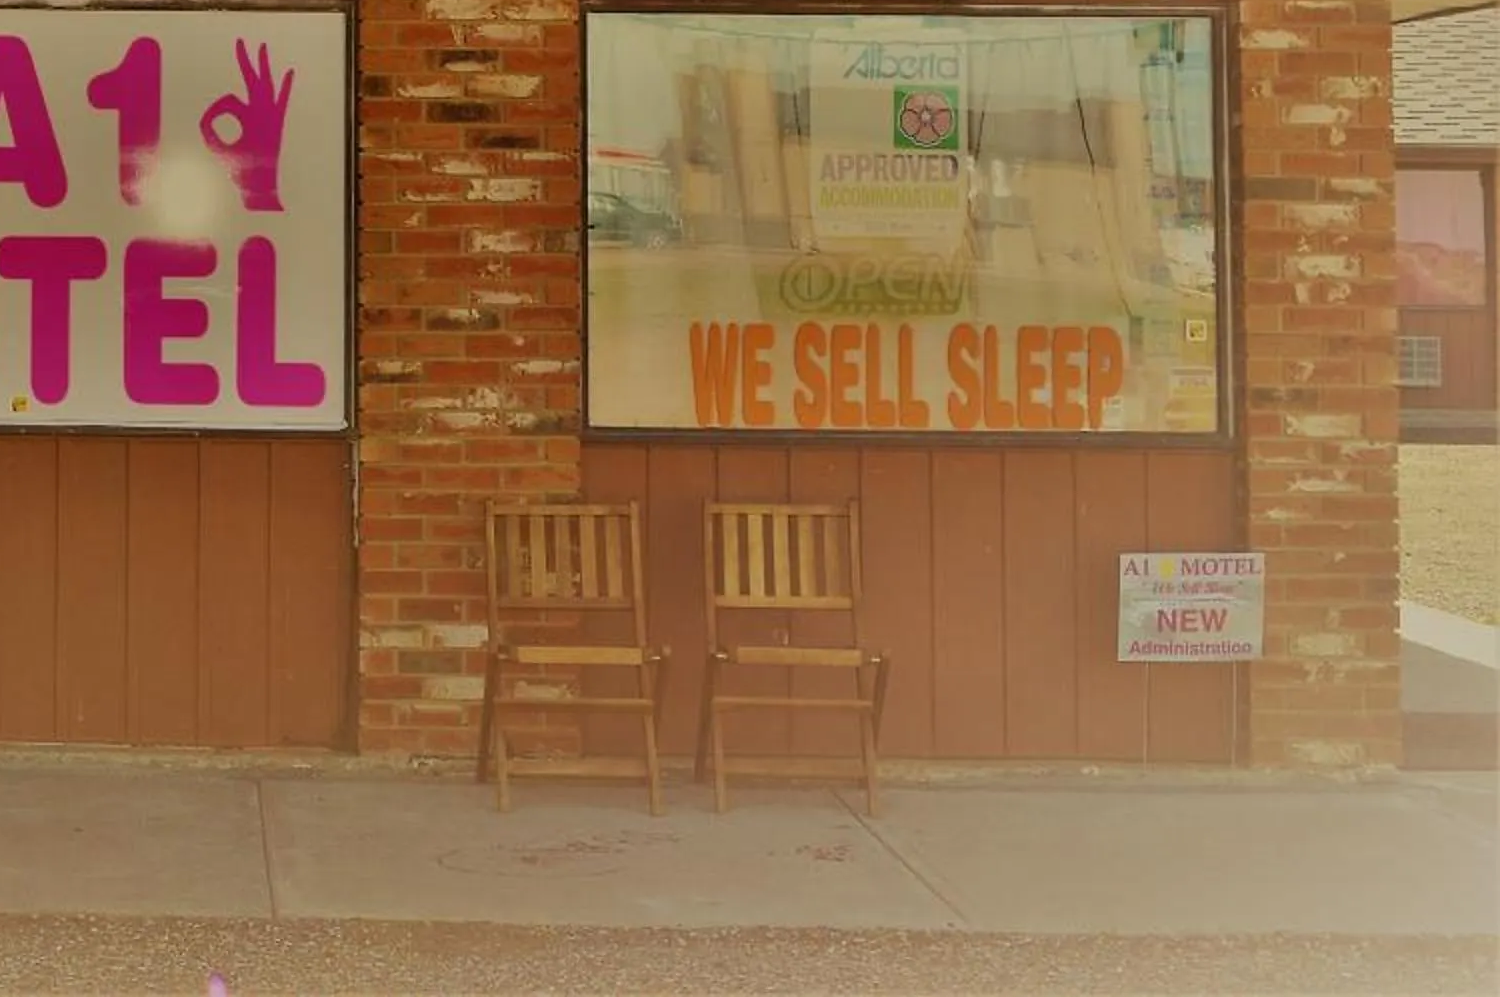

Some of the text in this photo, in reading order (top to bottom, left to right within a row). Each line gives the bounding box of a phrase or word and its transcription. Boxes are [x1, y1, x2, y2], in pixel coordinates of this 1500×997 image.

[843, 42, 960, 80] Alberta
[819, 154, 959, 182] APPROVED
[779, 254, 965, 312] OPEN
[689, 320, 1124, 431] WE SELL SLEEP
[1181, 558, 1261, 576] MOTEL
[1157, 608, 1228, 632] NEW
[1129, 640, 1253, 656] Administration
